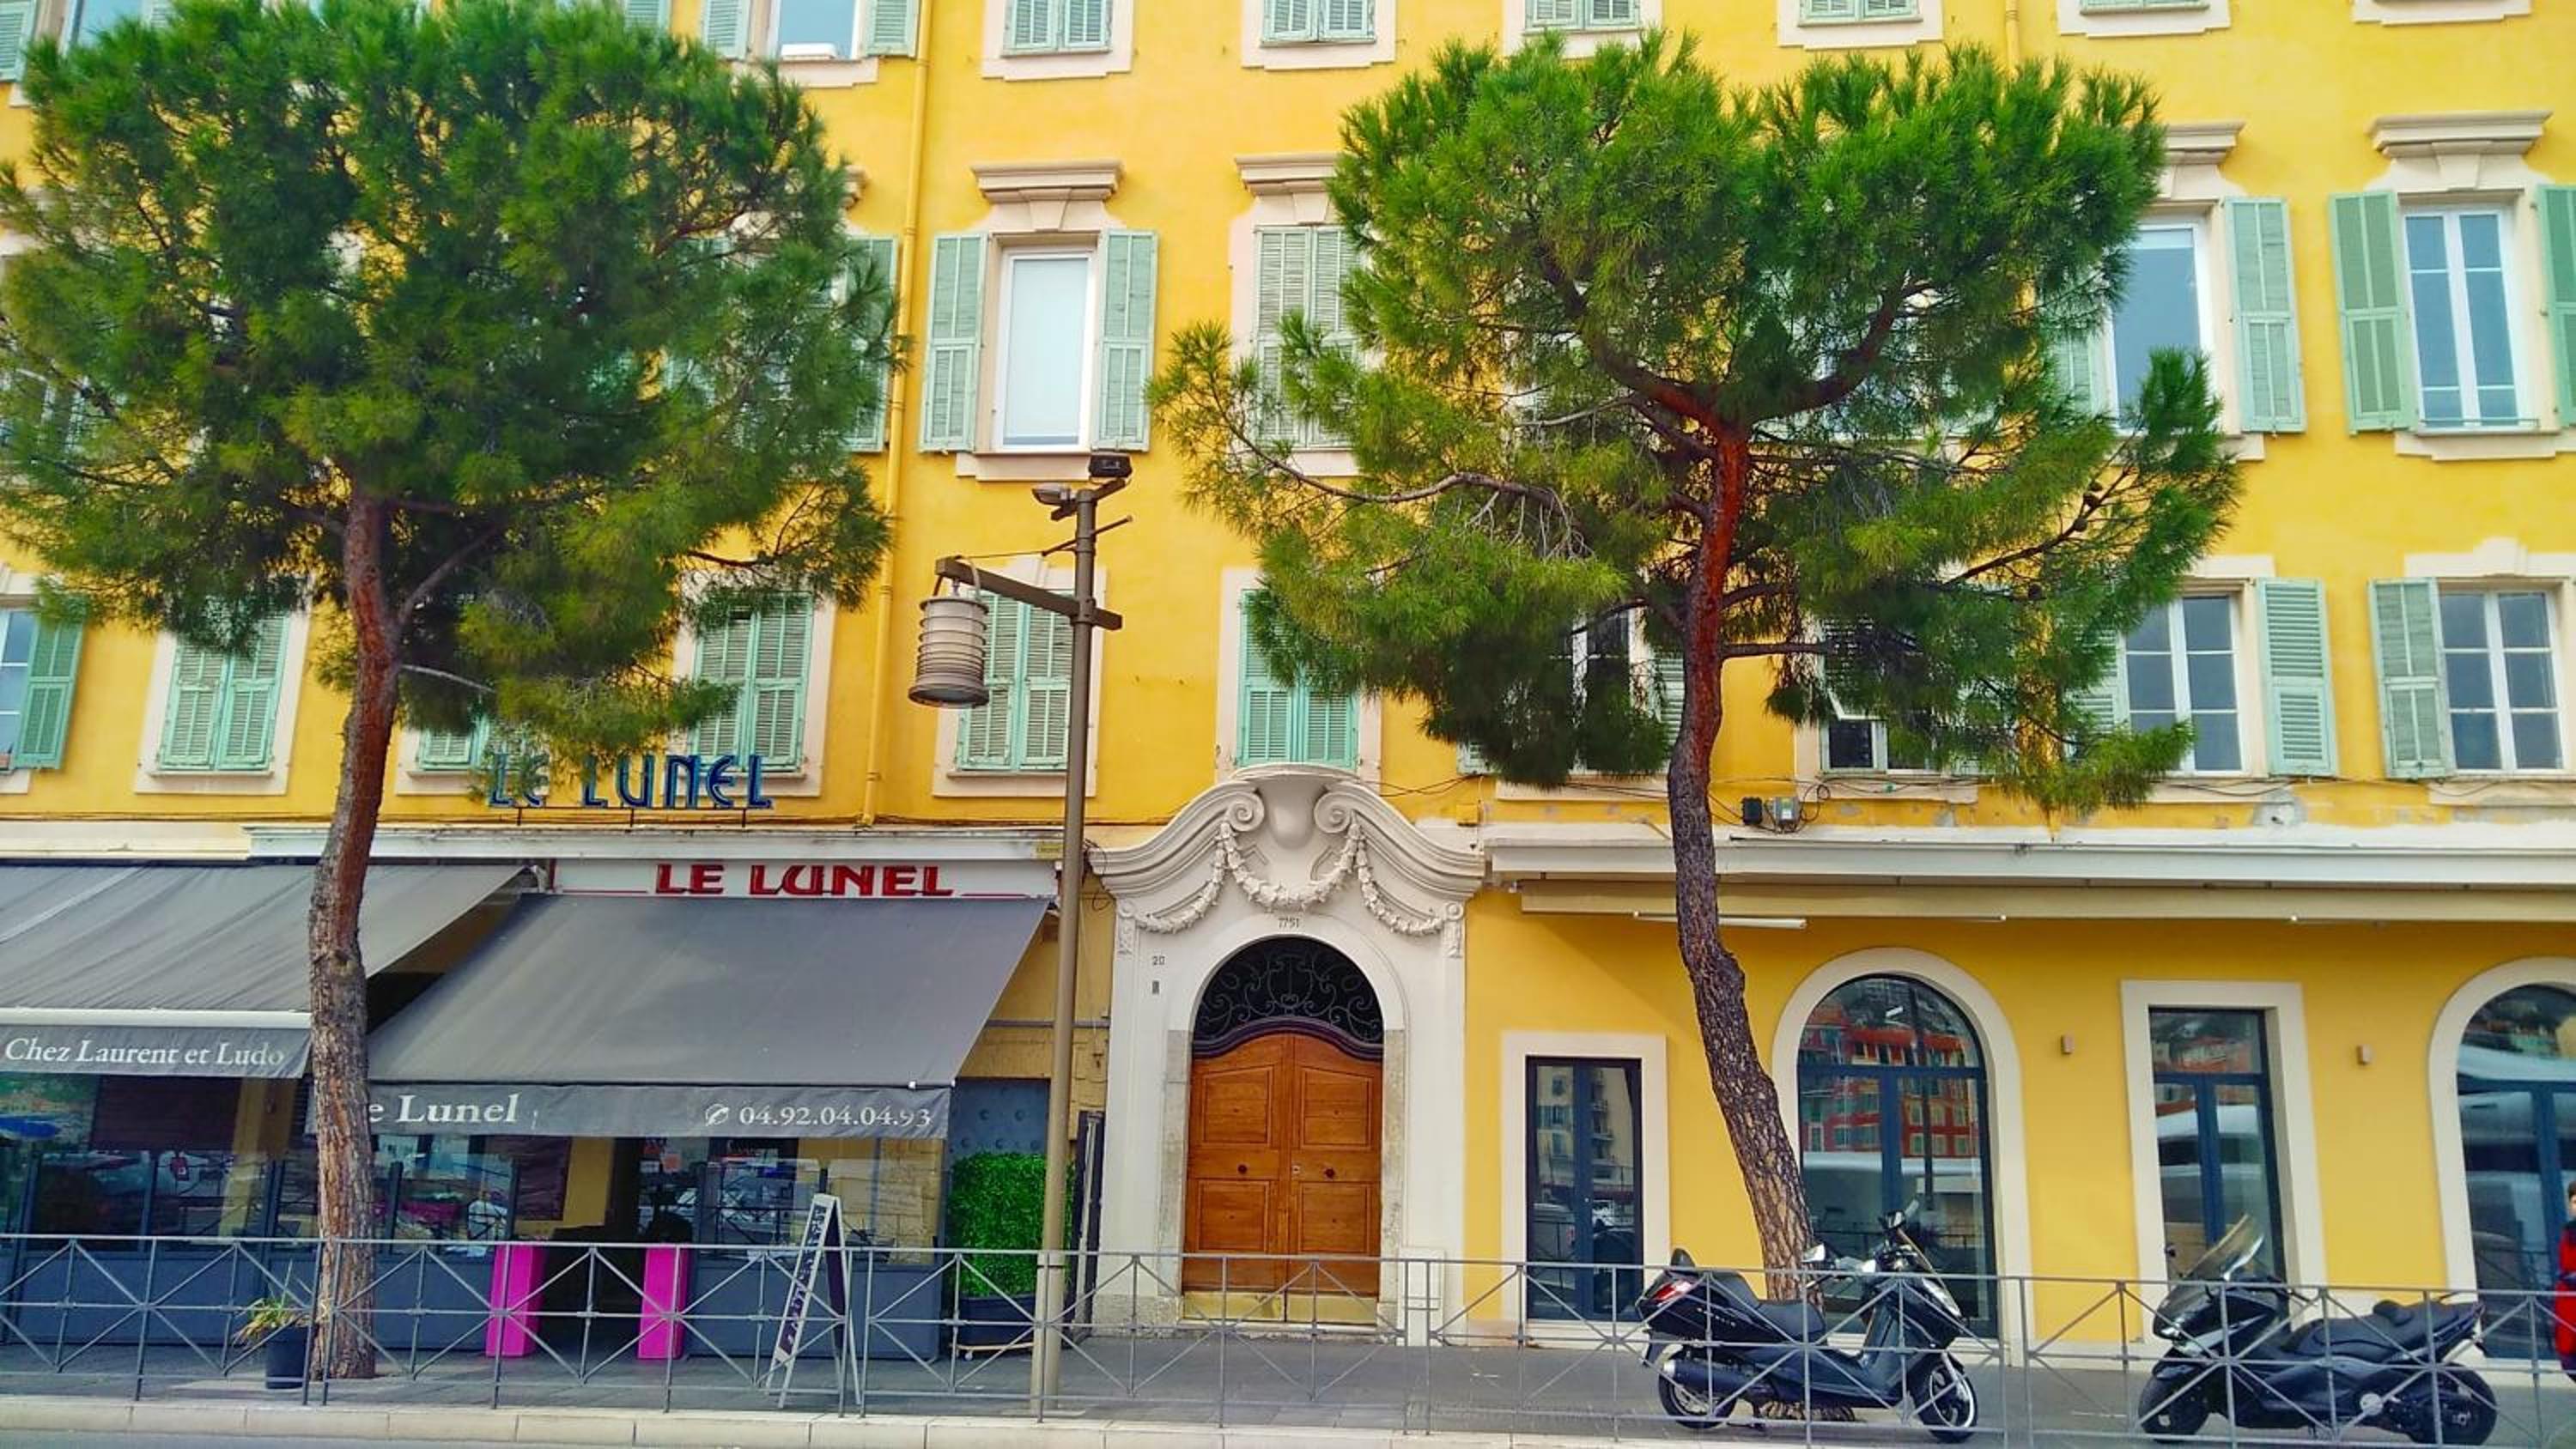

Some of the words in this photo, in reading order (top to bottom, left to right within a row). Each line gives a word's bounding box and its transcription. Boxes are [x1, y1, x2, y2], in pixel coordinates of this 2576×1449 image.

[581, 754, 773, 809] LUNEL
[655, 864, 725, 894] LE
[749, 864, 955, 897] LUNEL
[4, 1038, 70, 1063] Chez
[76, 1040, 179, 1064] Laurent
[185, 1043, 210, 1064] et
[216, 1041, 286, 1067] Ludo
[395, 1092, 522, 1124] Lunel
[739, 1105, 933, 1128] 04.92.04.04.93
